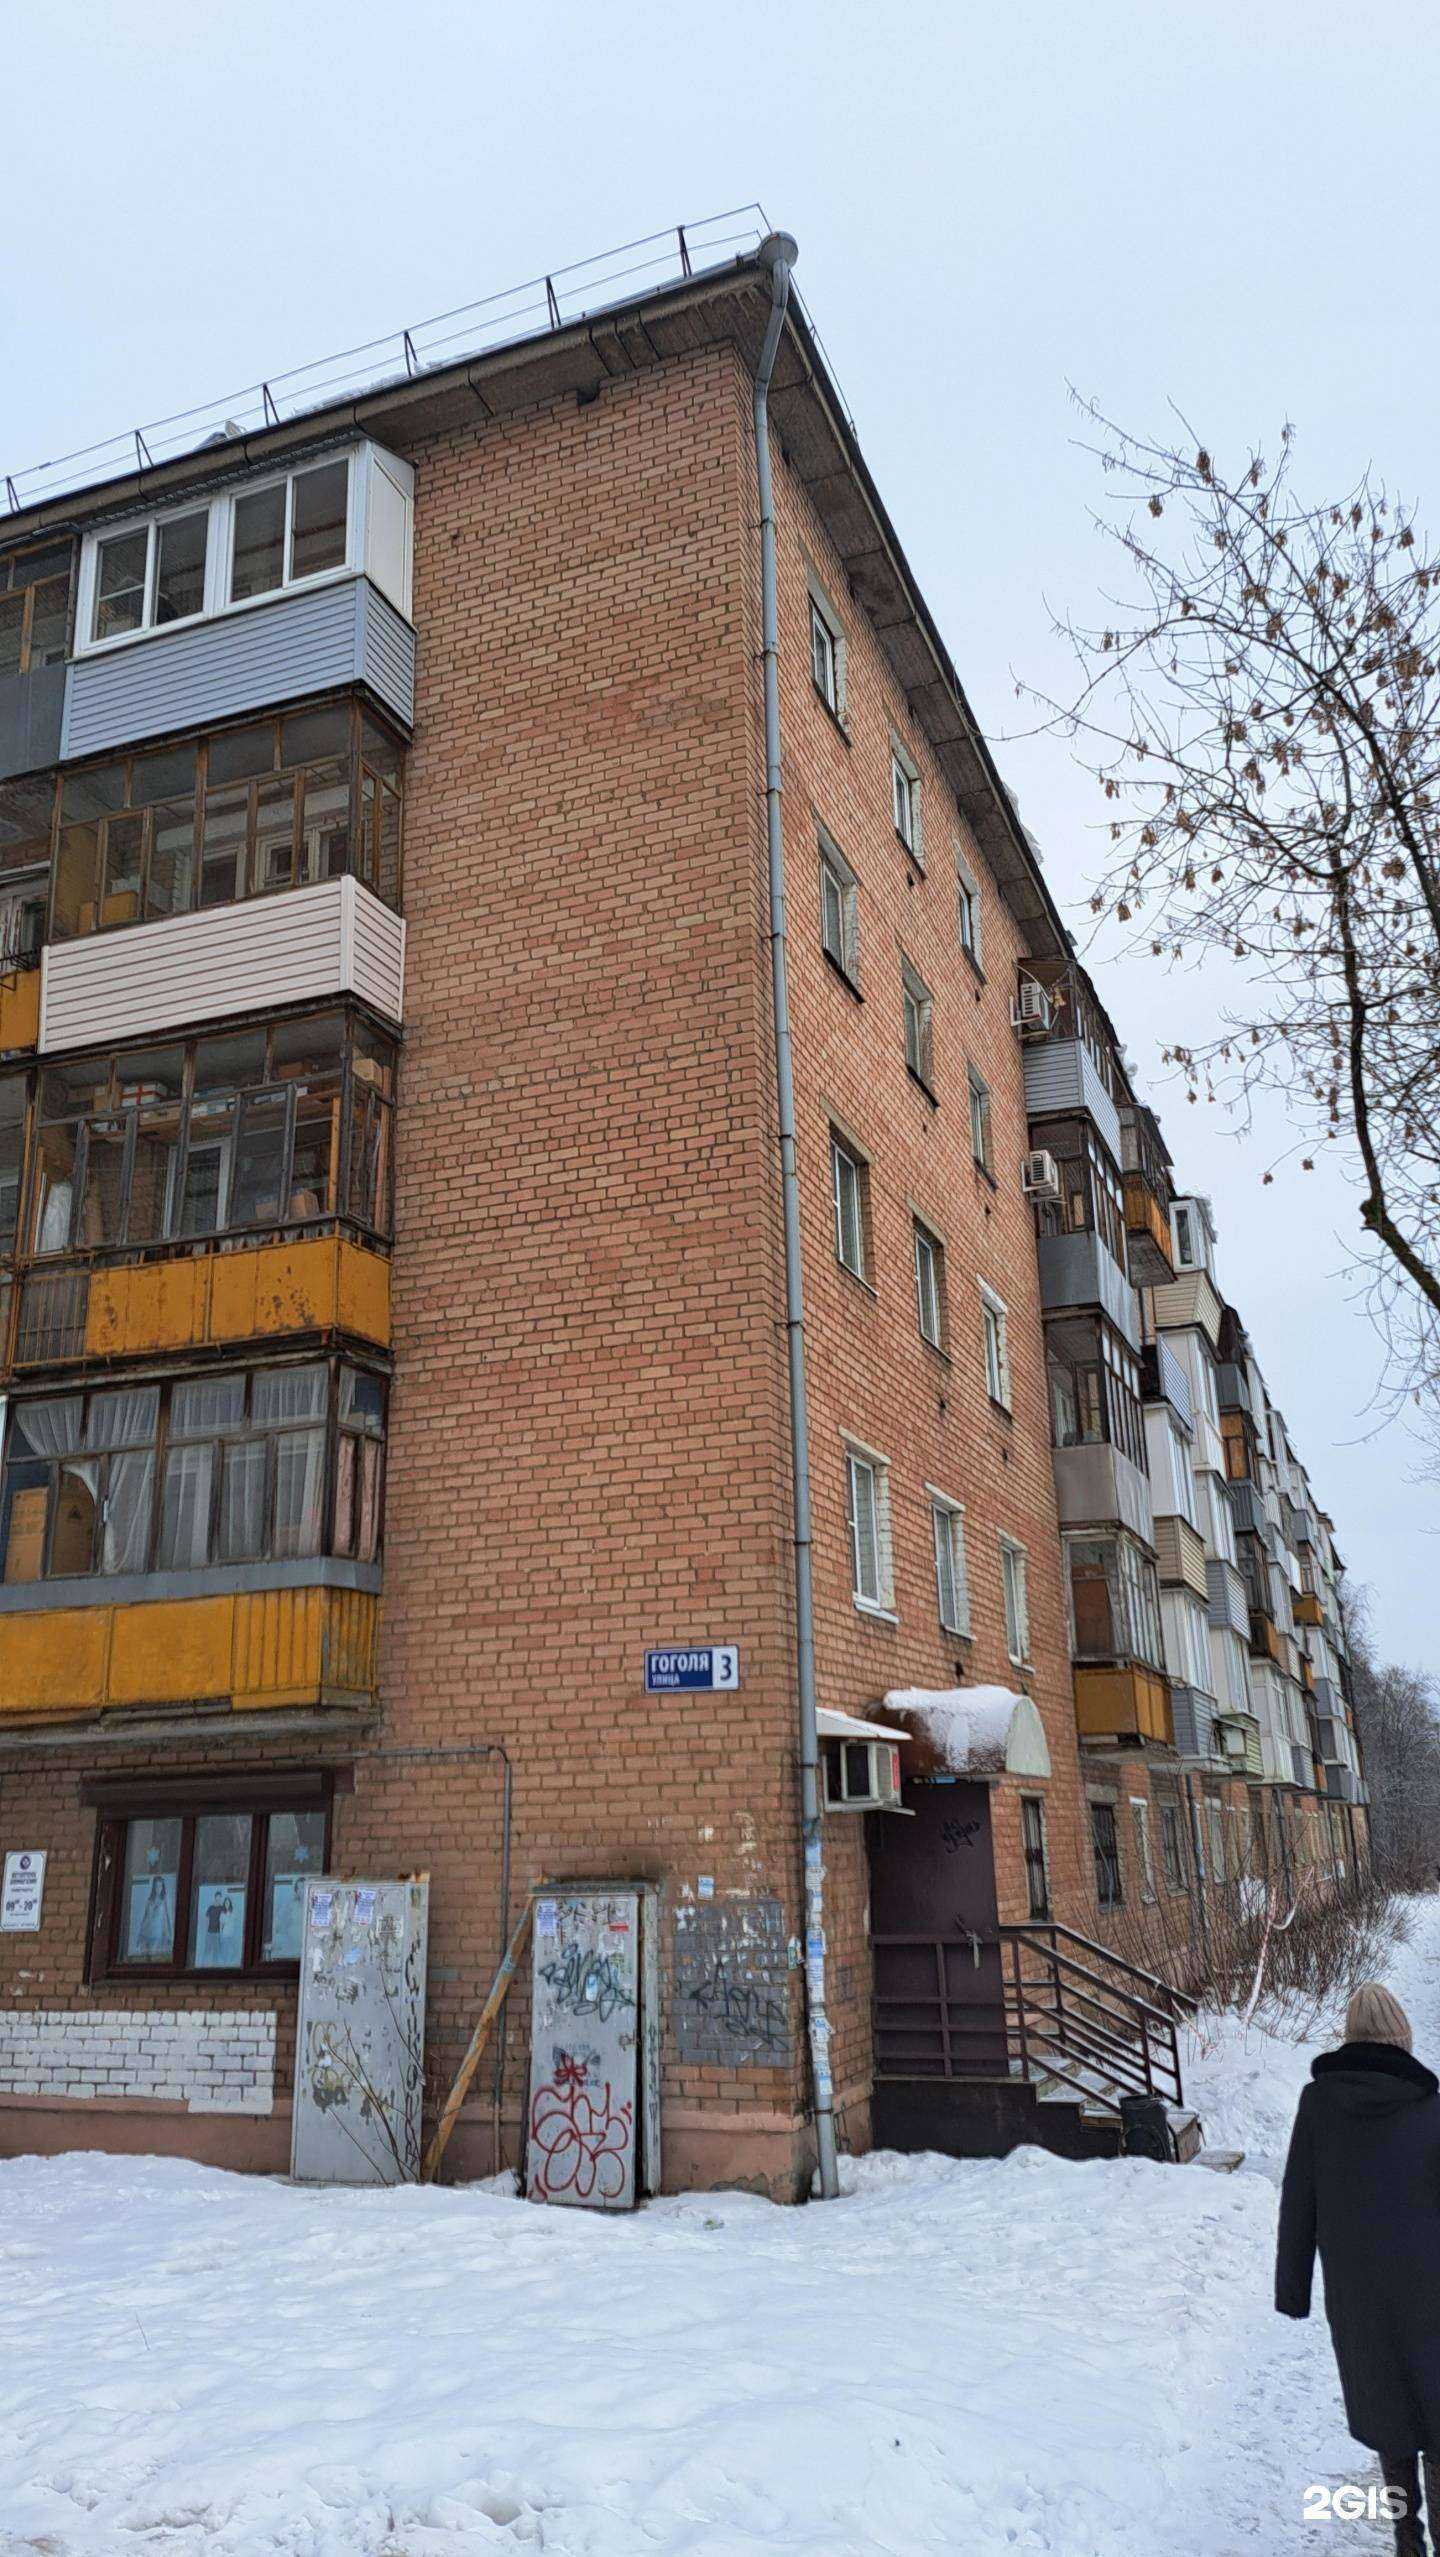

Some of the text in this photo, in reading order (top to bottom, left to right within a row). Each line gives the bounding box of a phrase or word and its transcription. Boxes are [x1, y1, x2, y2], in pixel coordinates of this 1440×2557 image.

[651, 1653, 732, 1681] ГОГОЛЯ 3
[651, 1673, 681, 1687] УЛИЦА
